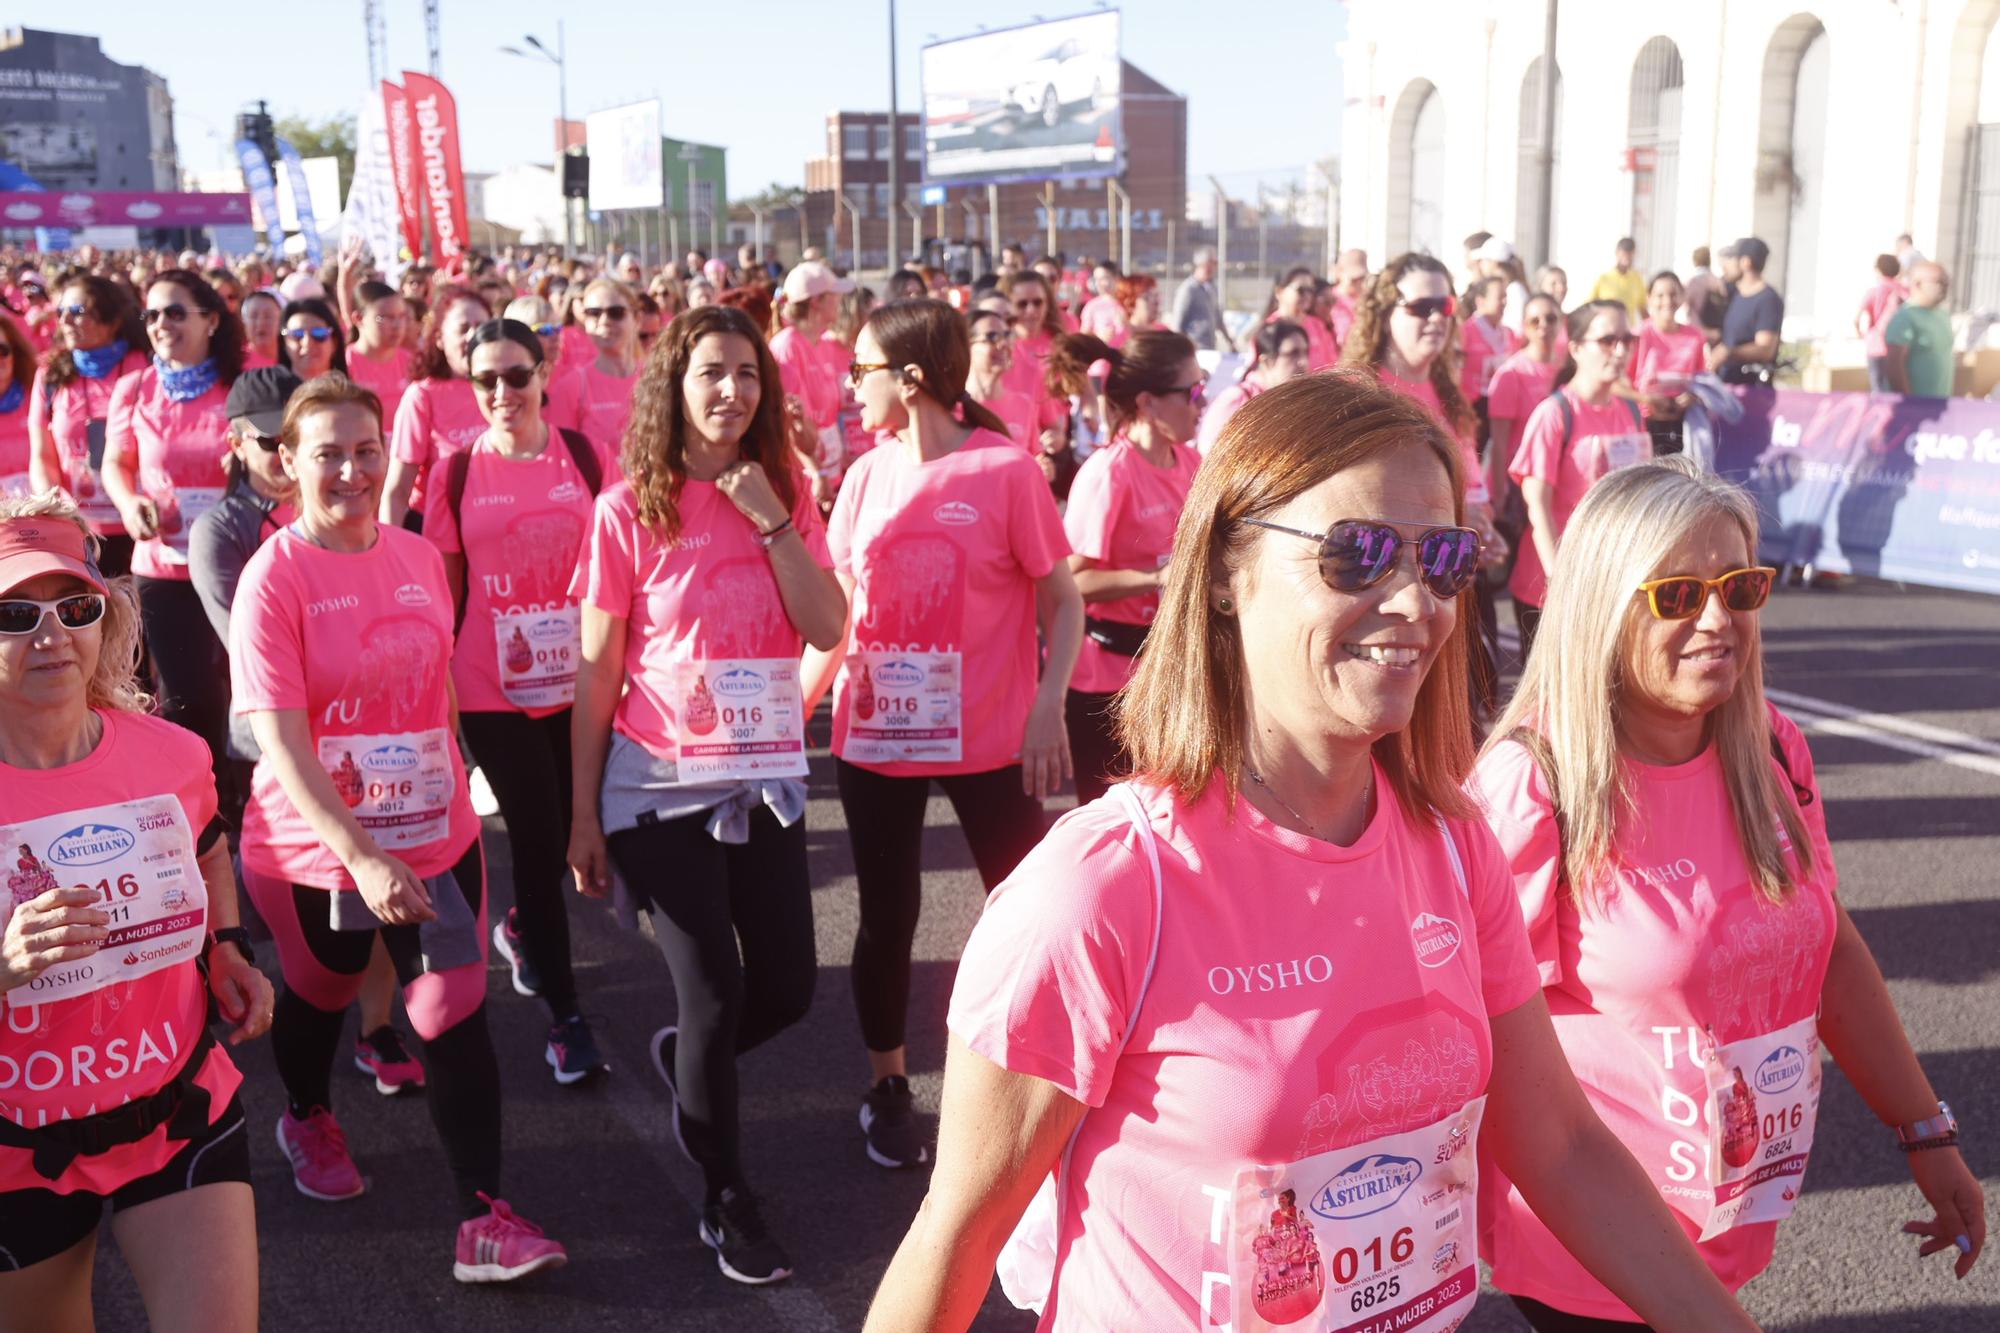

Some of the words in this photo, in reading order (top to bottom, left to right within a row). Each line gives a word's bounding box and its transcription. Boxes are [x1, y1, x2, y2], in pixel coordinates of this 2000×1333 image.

[482, 572, 512, 598] TU
[306, 594, 359, 617] OYSHO
[536, 645, 569, 664] 016
[722, 706, 763, 724] 016
[878, 696, 918, 713] 016
[885, 715, 911, 726] 3006
[730, 727, 756, 739] 3007
[369, 779, 413, 799] 016
[377, 801, 405, 813] 3012
[138, 817, 176, 833] SUMA
[57, 837, 130, 861] ASTURIANA
[73, 873, 139, 903] 16
[104, 905, 129, 923] 11
[108, 933, 122, 944] LA
[126, 923, 163, 942] MUJER
[167, 916, 192, 931] 2023
[140, 938, 194, 963] Santander
[29, 965, 95, 992] OYSHO
[1206, 954, 1334, 995] OYSHO
[1763, 1103, 1803, 1140] 016
[1433, 1137, 1468, 1165] SUMA
[1765, 1137, 1792, 1160] 6824
[1319, 1171, 1412, 1211] ASTURIANA
[1332, 1227, 1415, 1285] 016
[1350, 1275, 1401, 1313] 6825
[1375, 1318, 1393, 1333] LA
[1395, 1296, 1434, 1329] MUJER
[1436, 1279, 1462, 1304] 2023
